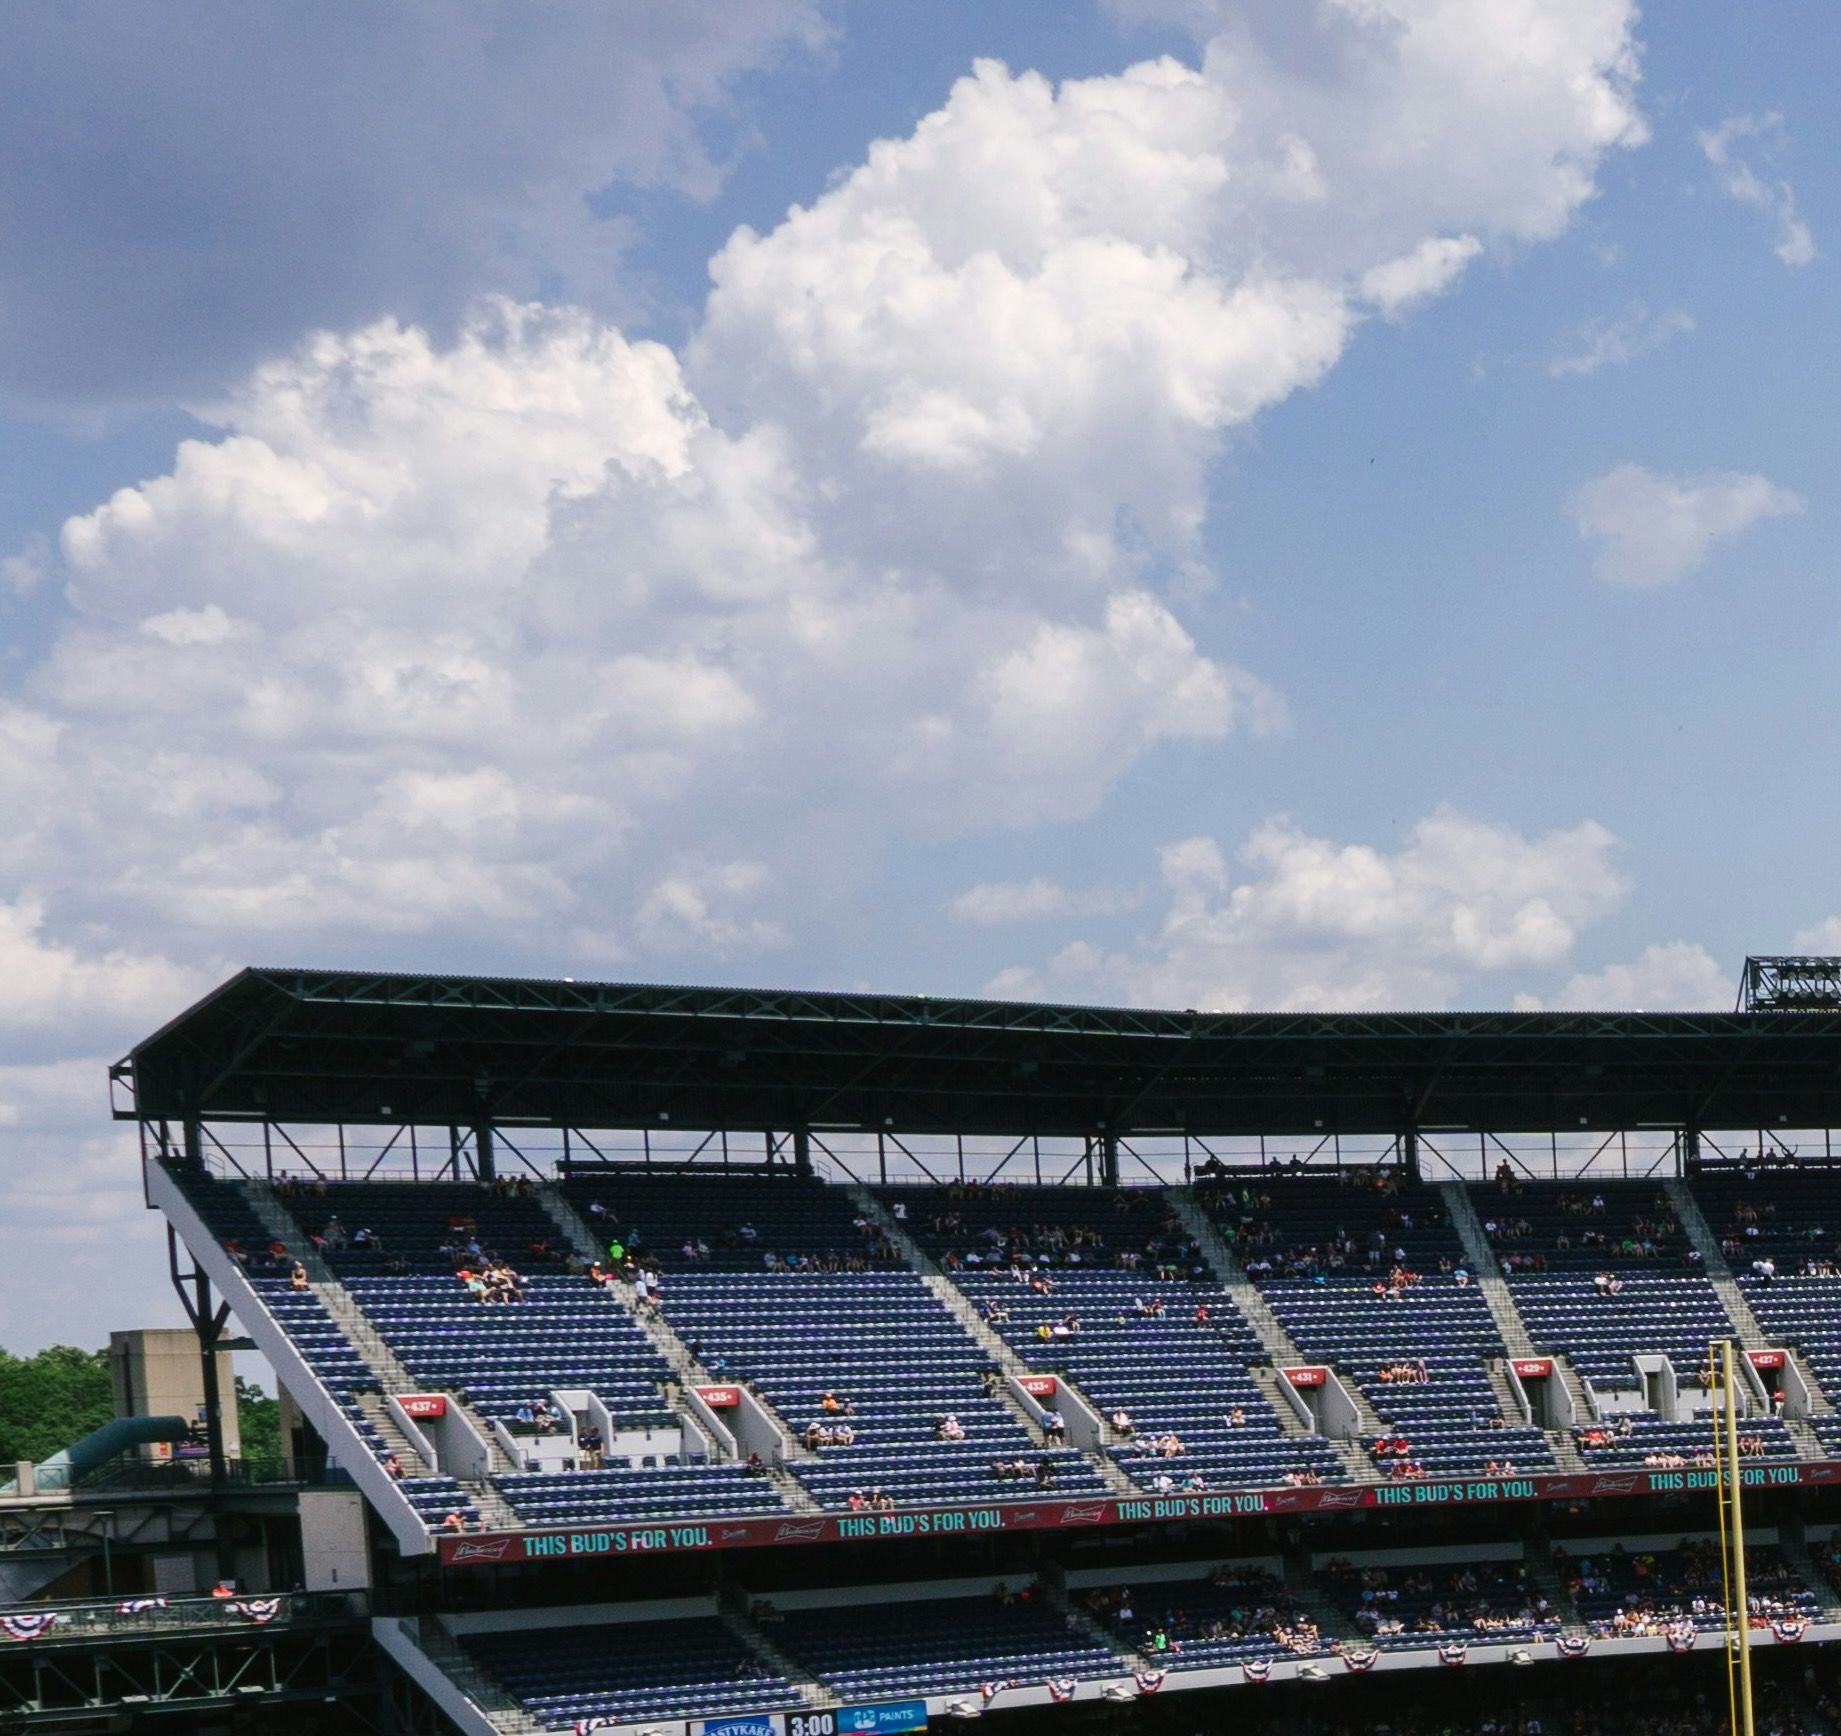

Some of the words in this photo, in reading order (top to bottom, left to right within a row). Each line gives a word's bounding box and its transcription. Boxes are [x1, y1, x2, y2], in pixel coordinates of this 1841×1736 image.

[1375, 1487, 1411, 1504] THIS
[1416, 1485, 1463, 1503] BUD'S
[1467, 1483, 1498, 1500] FOR
[1501, 1481, 1538, 1498] YOU.
[1117, 1502, 1152, 1519] THIS
[1155, 1500, 1200, 1517] BUD'S
[1203, 1497, 1231, 1514] FOR
[1234, 1496, 1269, 1511] YOU.
[838, 1518, 875, 1537] THIS
[880, 1516, 929, 1535] BUD'S
[933, 1513, 965, 1531] FOR
[968, 1511, 1005, 1529] YOU.
[523, 1536, 566, 1556] THIS
[571, 1533, 627, 1553] BUD'S
[631, 1530, 667, 1549] FOR
[668, 1528, 711, 1547] YOU.
[879, 1710, 914, 1722] PAINTS
